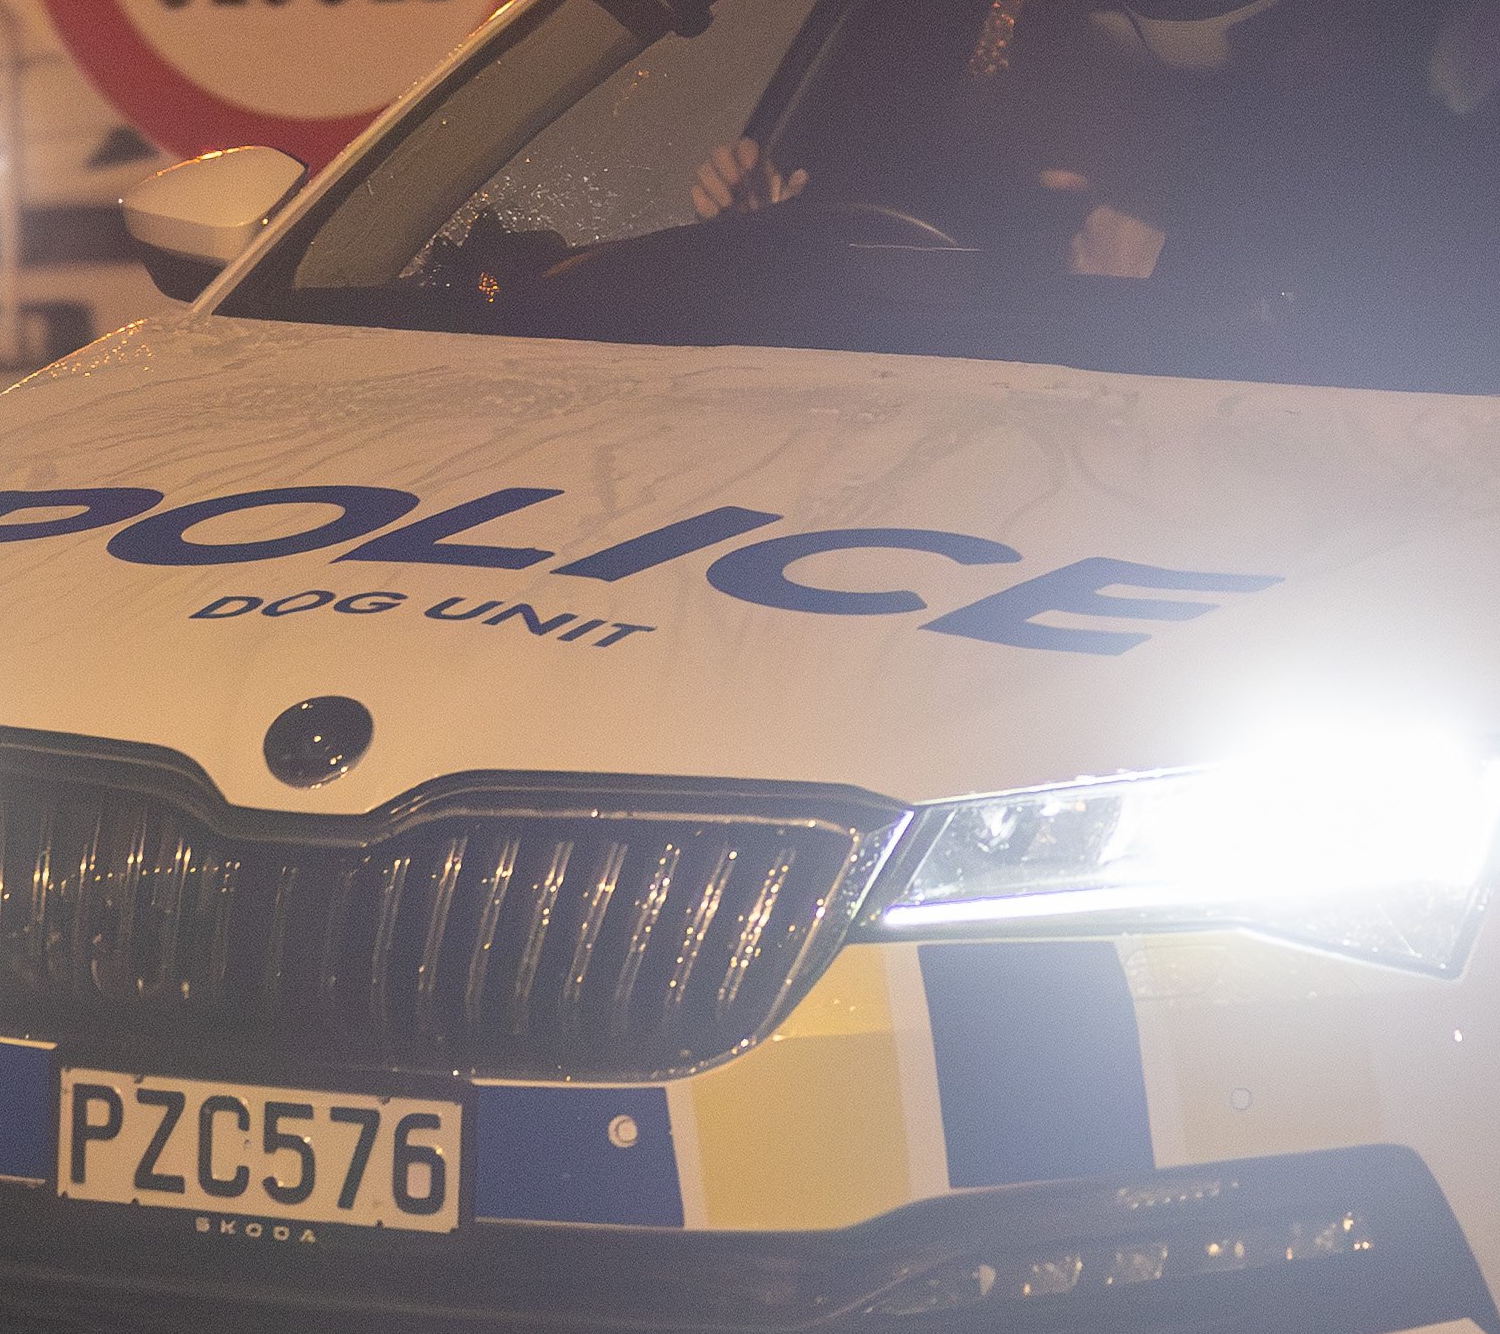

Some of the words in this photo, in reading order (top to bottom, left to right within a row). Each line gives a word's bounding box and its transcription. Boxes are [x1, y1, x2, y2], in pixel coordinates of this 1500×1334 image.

[190, 588, 409, 621] DOG
[425, 598, 657, 649] UNIT
[69, 1083, 448, 1216] PZC576
[195, 1216, 318, 1243] SKODA
